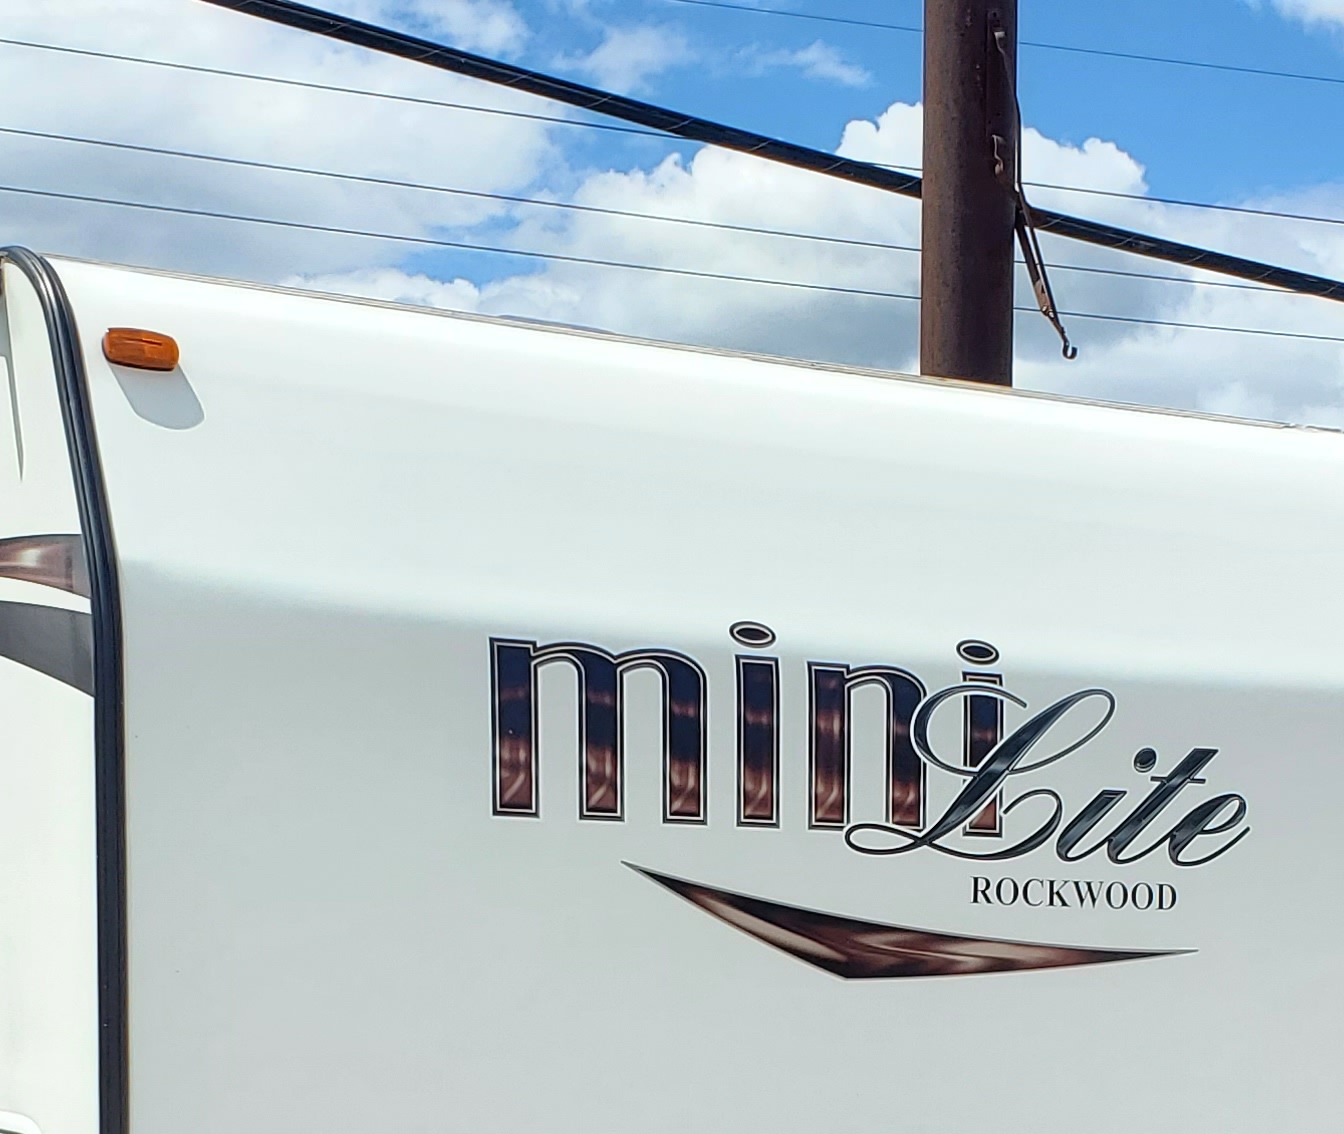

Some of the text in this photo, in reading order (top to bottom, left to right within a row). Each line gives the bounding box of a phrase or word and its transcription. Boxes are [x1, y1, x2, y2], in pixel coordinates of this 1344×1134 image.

[488, 620, 1005, 838] mini
[843, 687, 1251, 867] Lite
[970, 875, 1179, 913] ROCKWOOD
